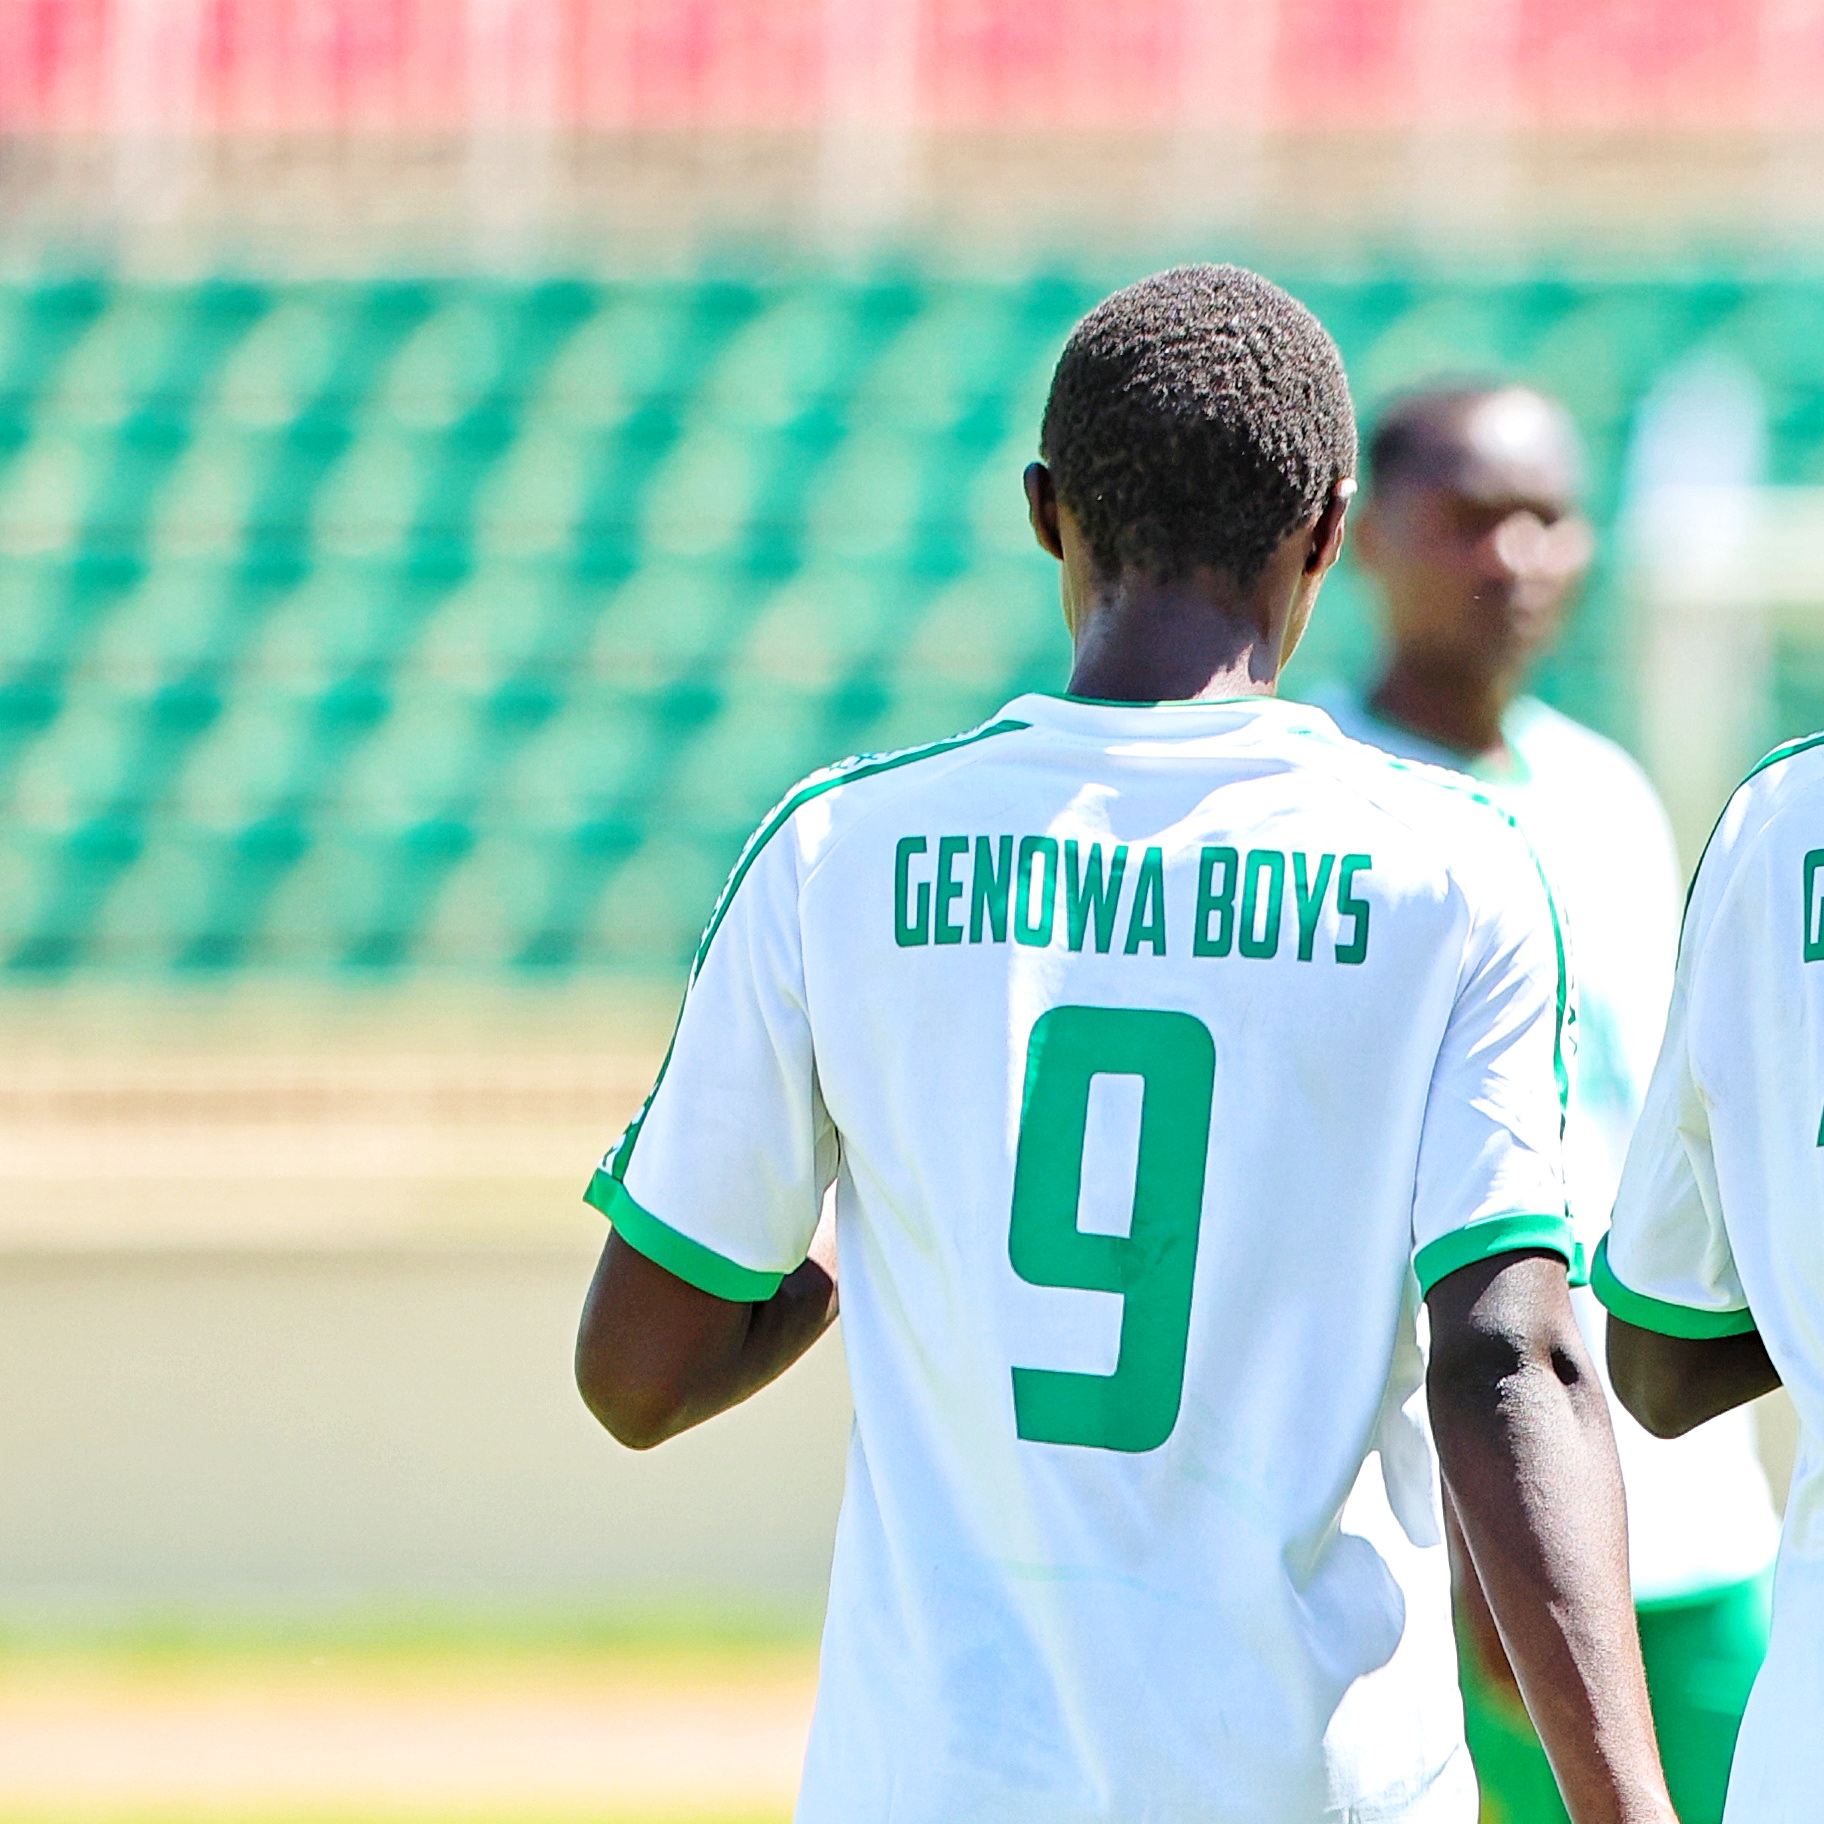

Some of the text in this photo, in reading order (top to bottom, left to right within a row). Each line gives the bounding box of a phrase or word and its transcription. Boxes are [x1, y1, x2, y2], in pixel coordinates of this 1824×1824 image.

[892, 831, 1373, 965] GENOWA BOYS
[1006, 1001, 1218, 1454] 9
